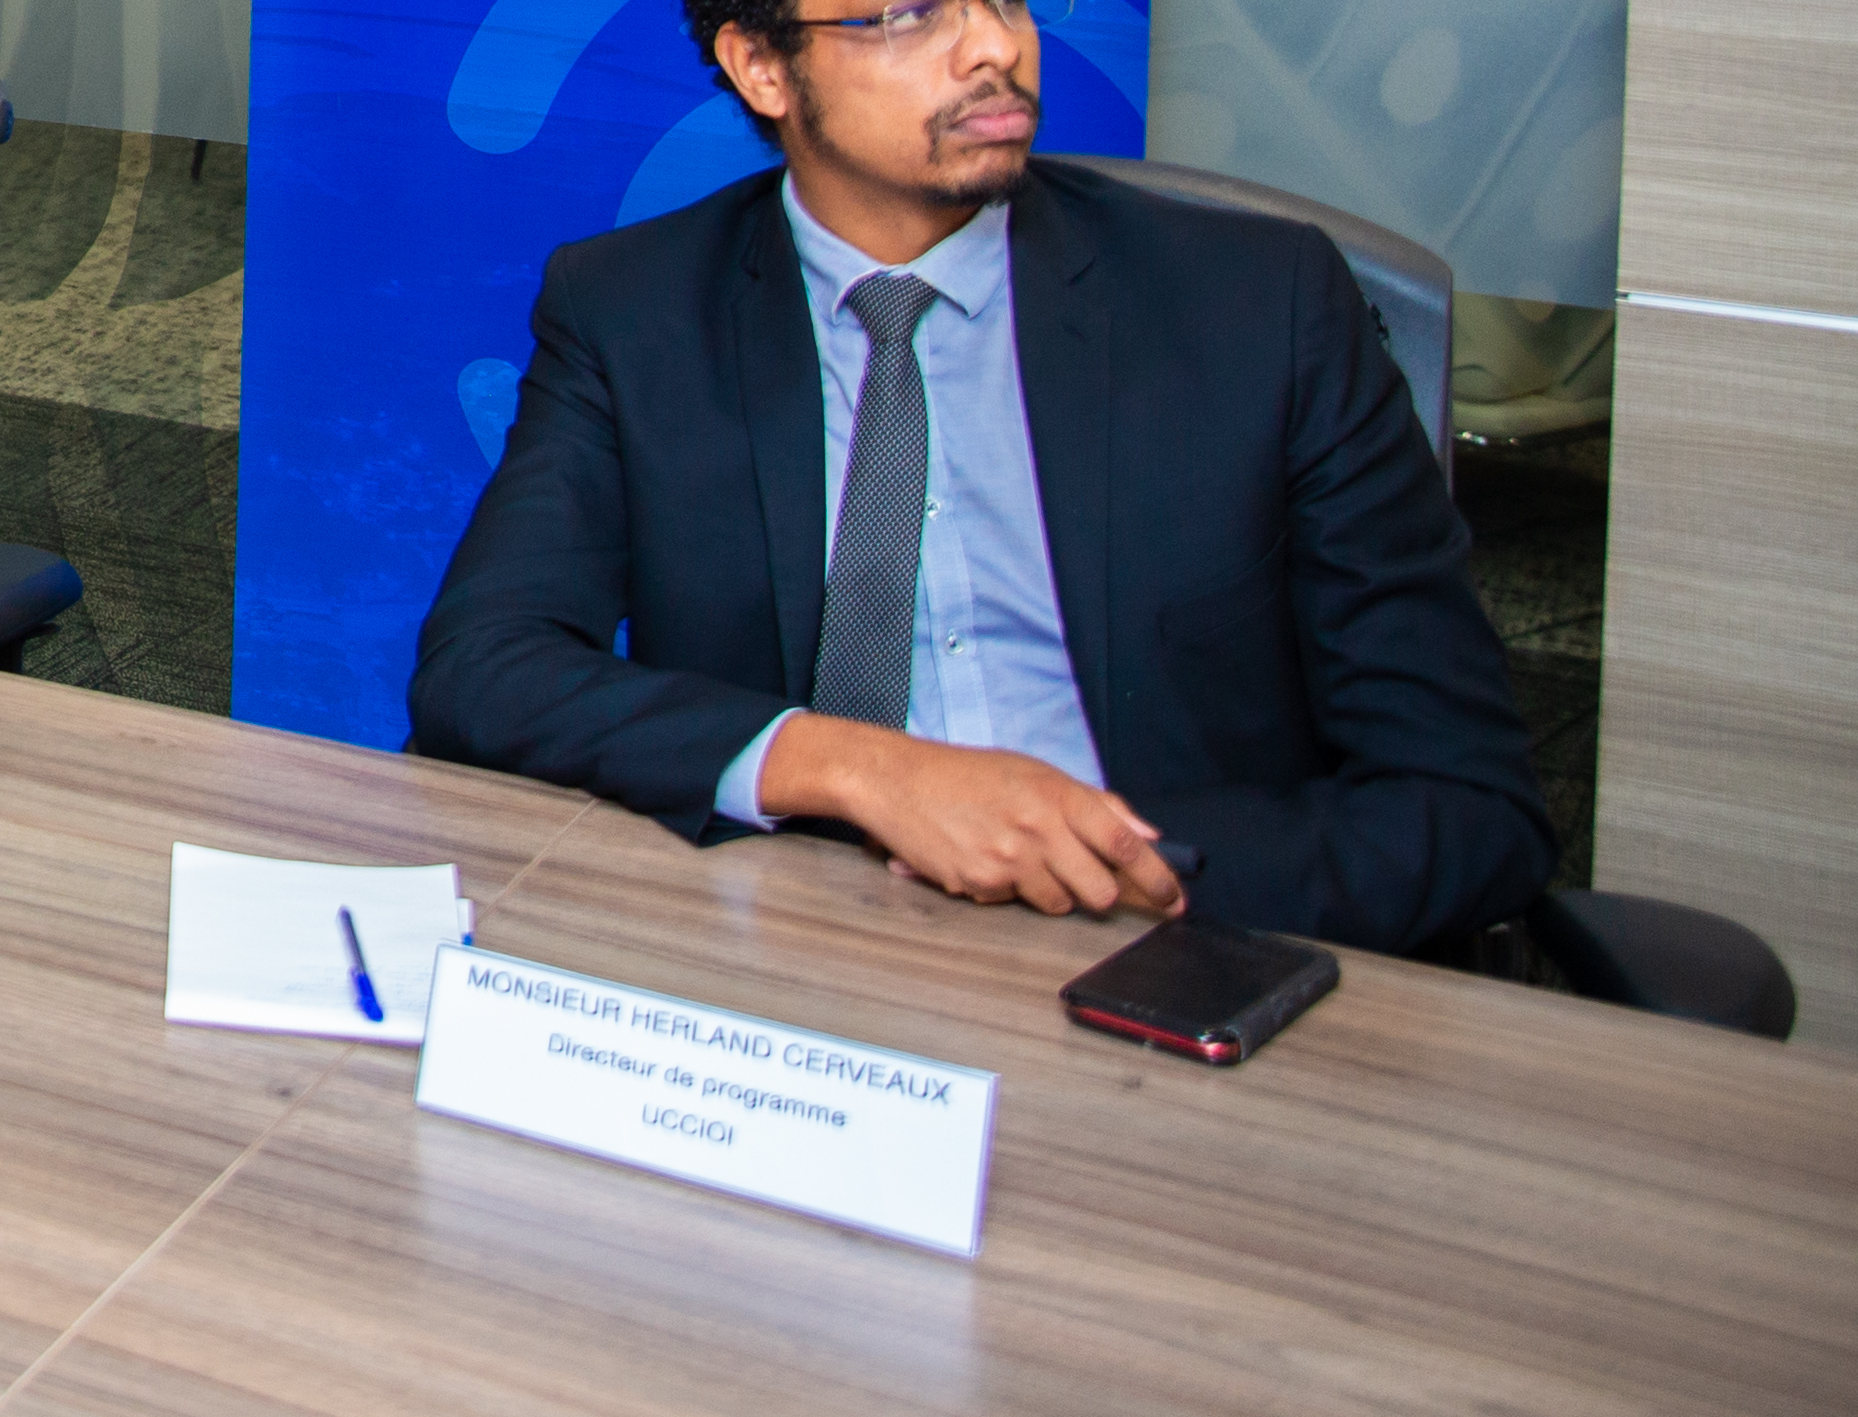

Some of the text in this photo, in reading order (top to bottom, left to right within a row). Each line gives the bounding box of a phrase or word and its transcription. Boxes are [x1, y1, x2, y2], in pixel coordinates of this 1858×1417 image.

[467, 963, 953, 1105] MONSIEUR HERLAND CERVEAUX
[547, 1032, 849, 1127] Directeur de programme
[641, 1104, 734, 1147] UCCIOI
